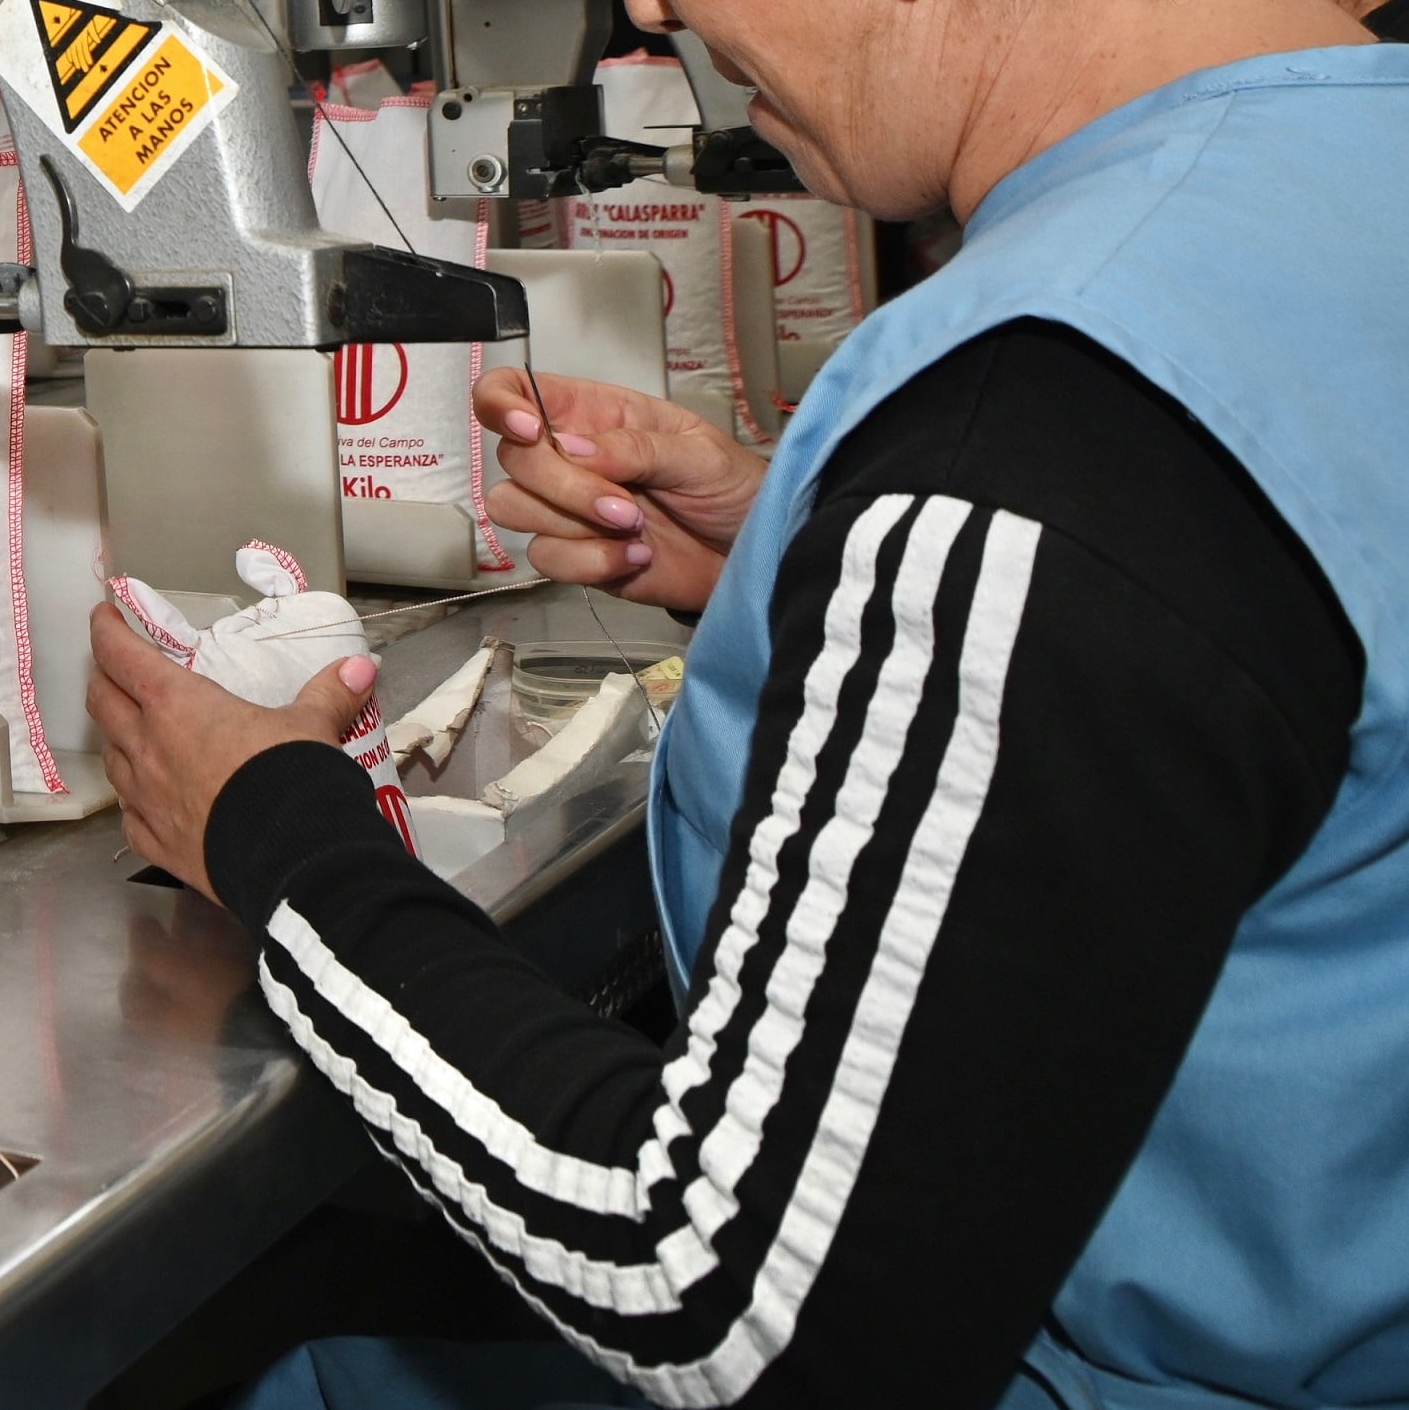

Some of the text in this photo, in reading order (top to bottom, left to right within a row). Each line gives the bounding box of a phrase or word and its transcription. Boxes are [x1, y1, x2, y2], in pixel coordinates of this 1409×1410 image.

[98, 55, 172, 143] ATENCION
[128, 89, 172, 141] A LAS
[135, 97, 194, 165] MANOS
[341, 454, 356, 466] LA
[357, 437, 375, 448] del
[379, 437, 424, 449] Campo
